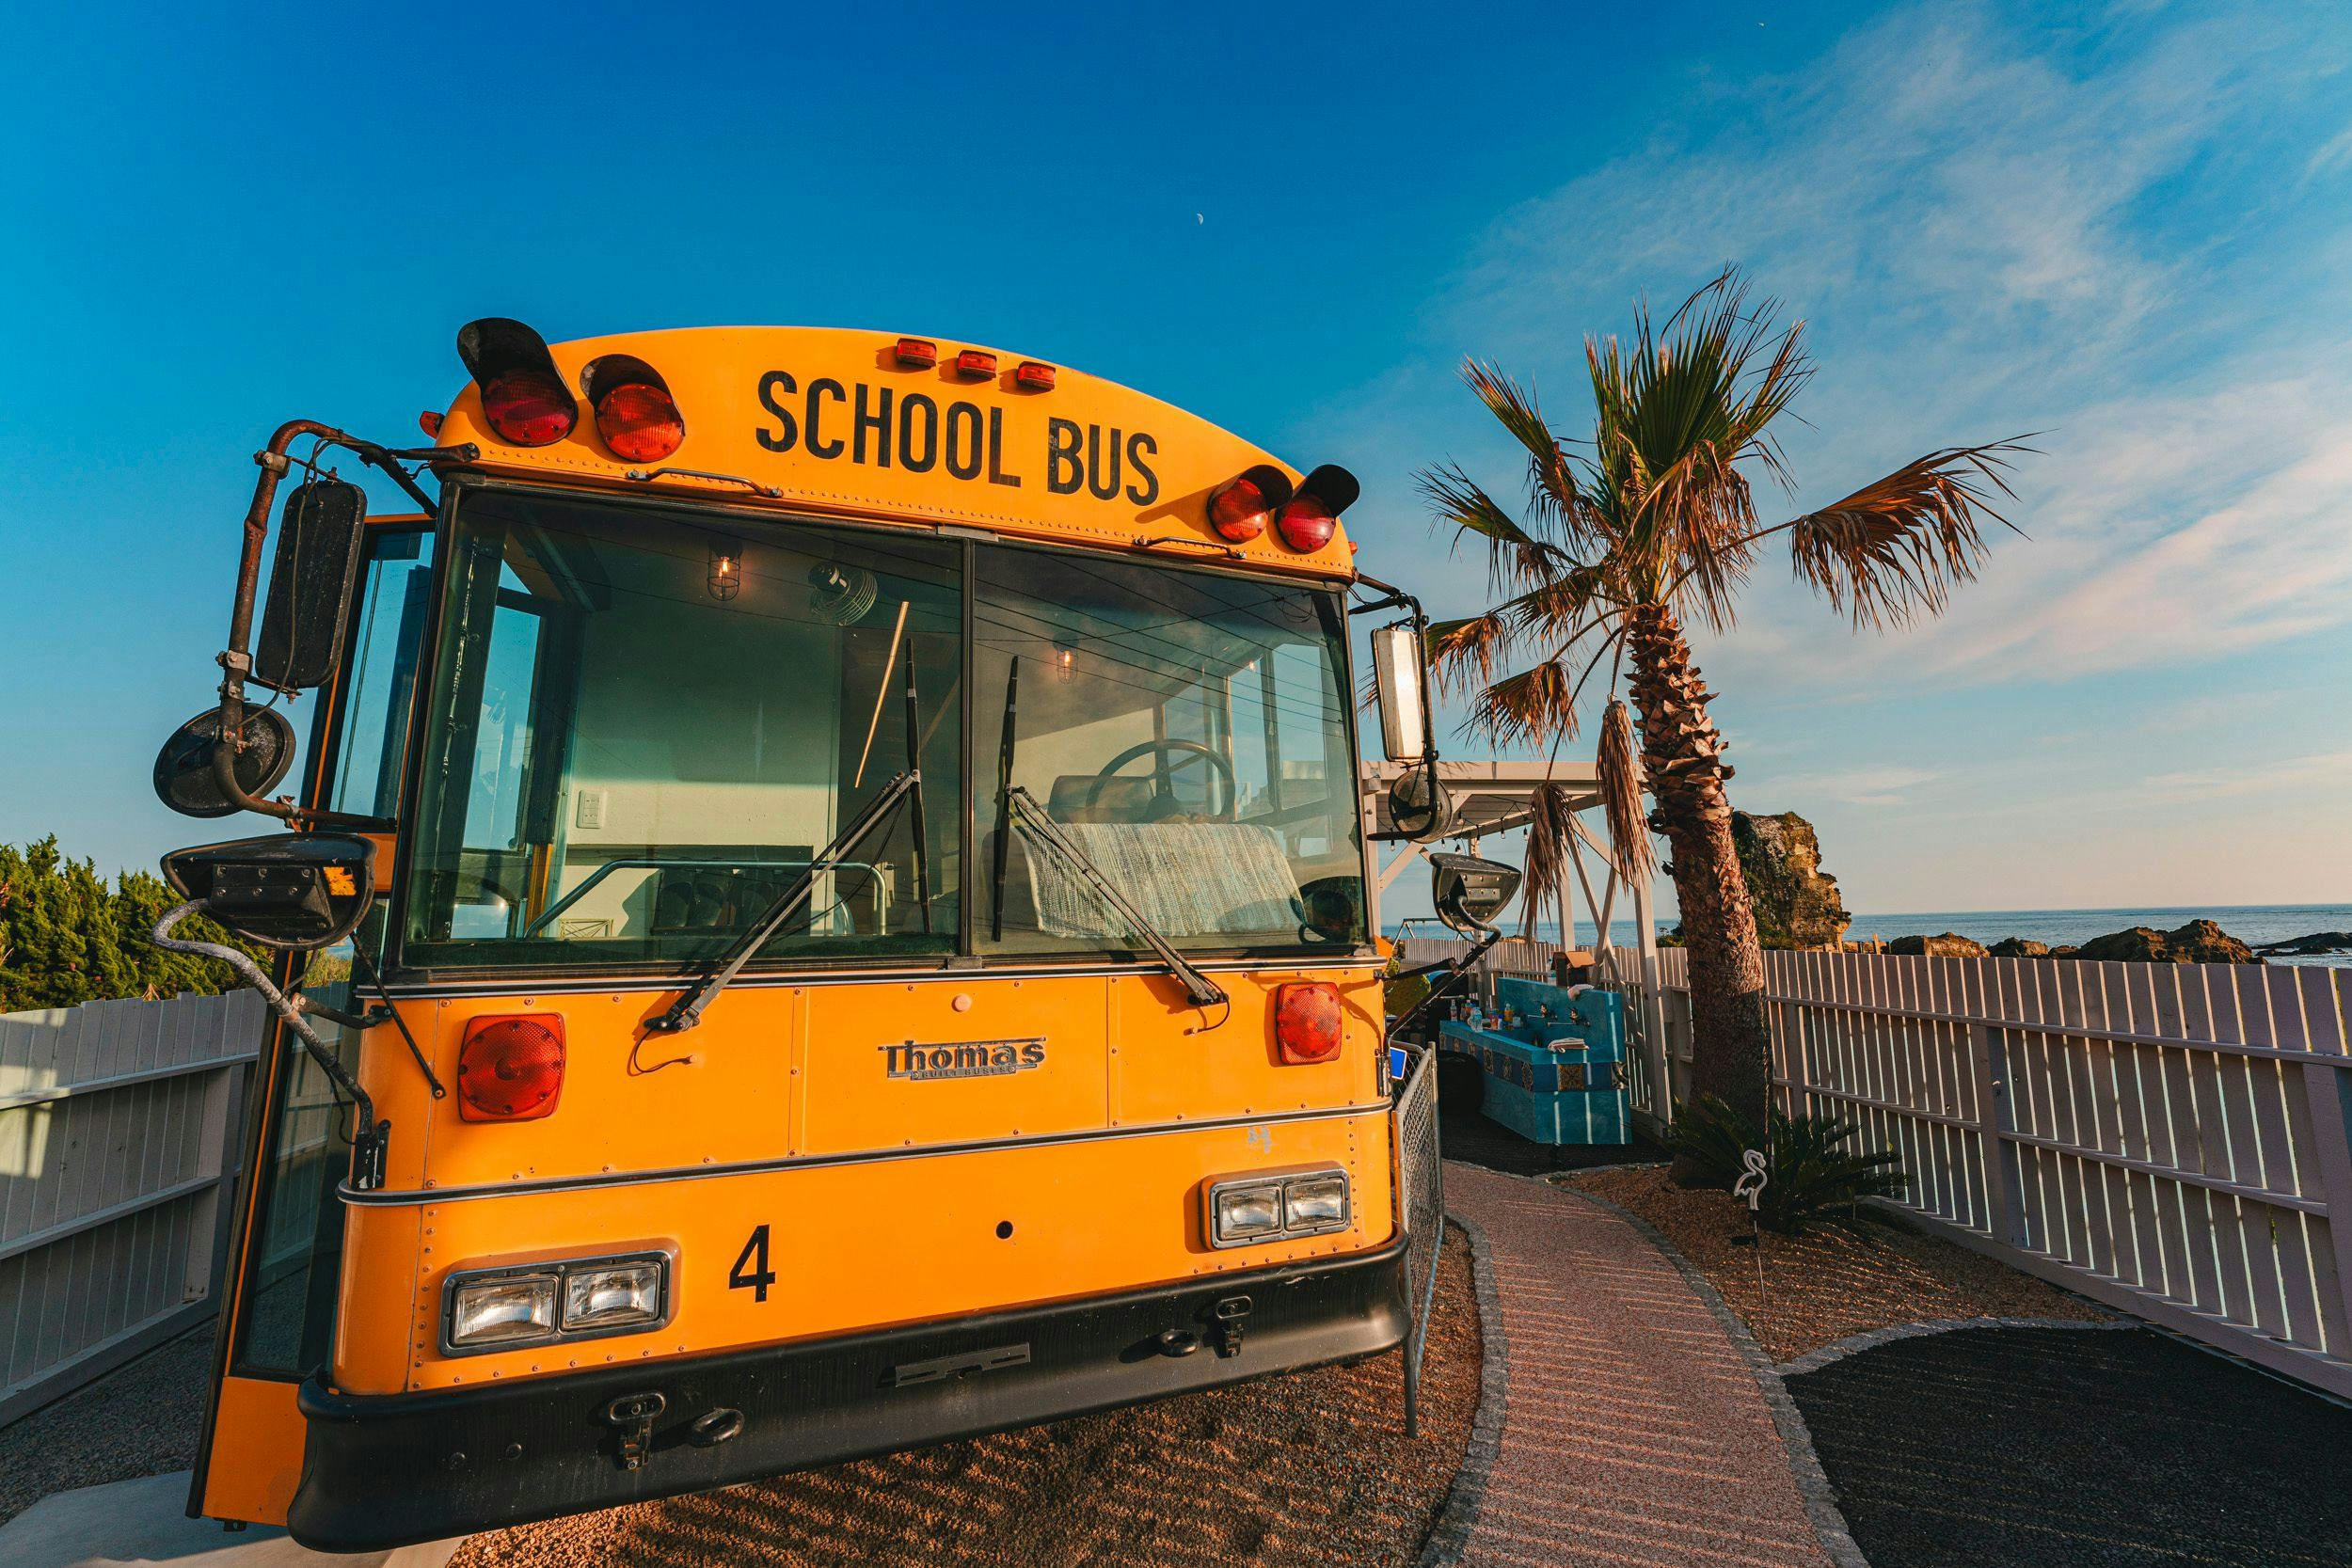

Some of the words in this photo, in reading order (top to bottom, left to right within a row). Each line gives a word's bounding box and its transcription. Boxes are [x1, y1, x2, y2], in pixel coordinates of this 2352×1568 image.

[755, 370, 1021, 487] SCHOOL
[1047, 416, 1160, 506] BUS
[881, 1038, 1046, 1075] Thomas
[729, 1224, 776, 1303] 4
